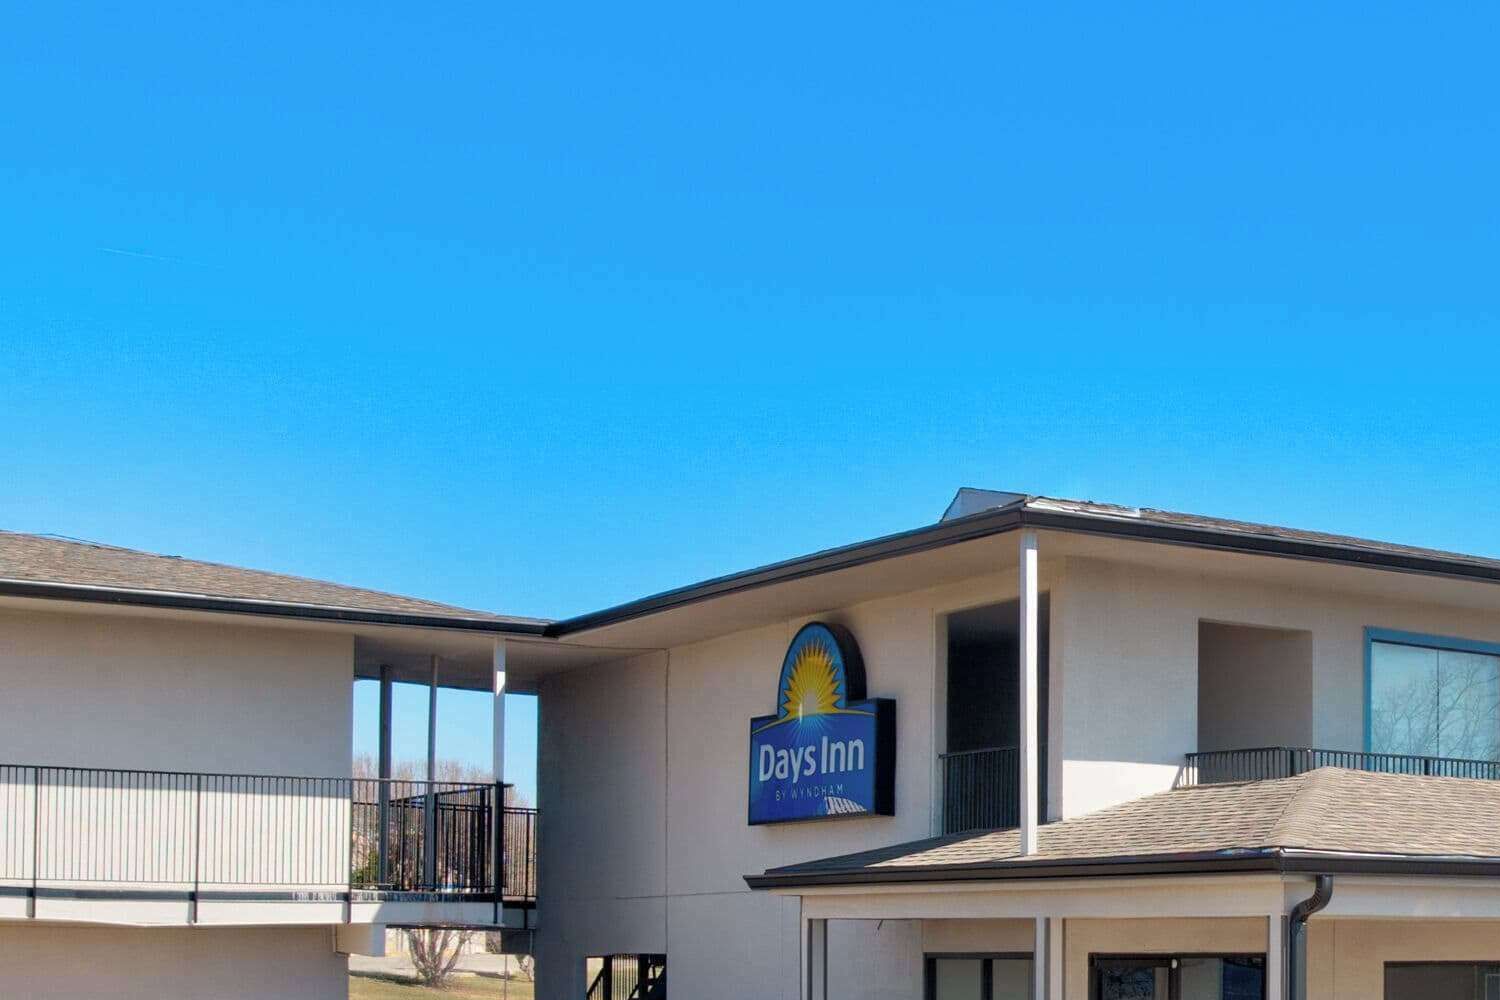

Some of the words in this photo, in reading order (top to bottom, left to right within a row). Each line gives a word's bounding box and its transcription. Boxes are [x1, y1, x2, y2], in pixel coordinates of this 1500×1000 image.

[759, 743, 816, 783] Days
[821, 736, 865, 774] Inn
[775, 788, 789, 801] BY
[791, 784, 844, 800] WYNDHAM
